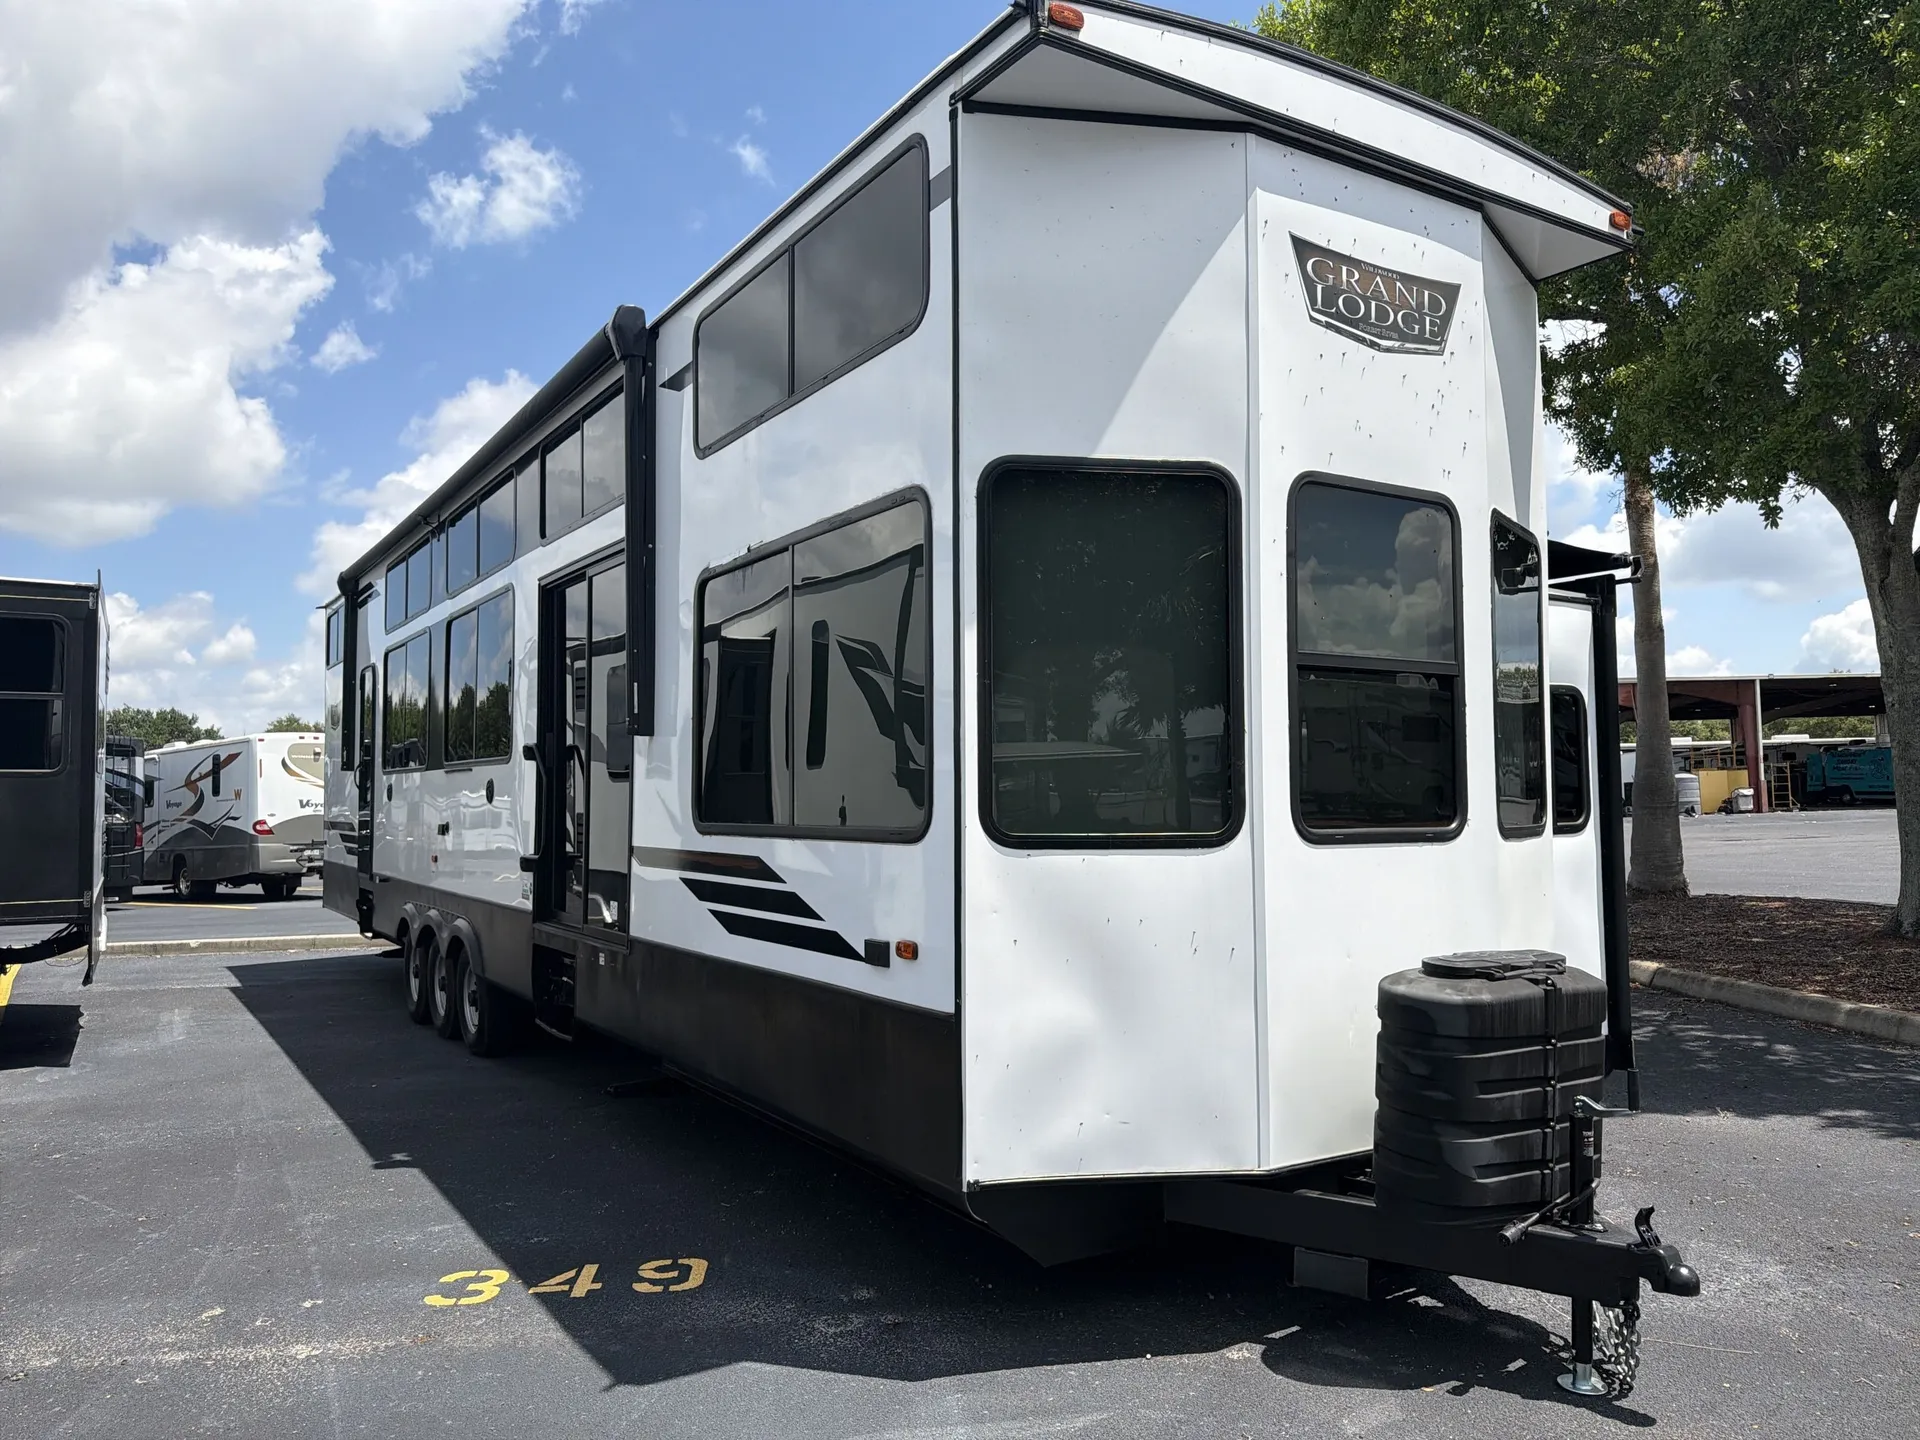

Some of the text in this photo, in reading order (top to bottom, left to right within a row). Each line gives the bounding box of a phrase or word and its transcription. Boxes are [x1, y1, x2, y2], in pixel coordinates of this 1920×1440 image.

[1306, 257, 1447, 316] GRAND
[1313, 283, 1442, 341] LODGE
[166, 799, 182, 809] Voyage
